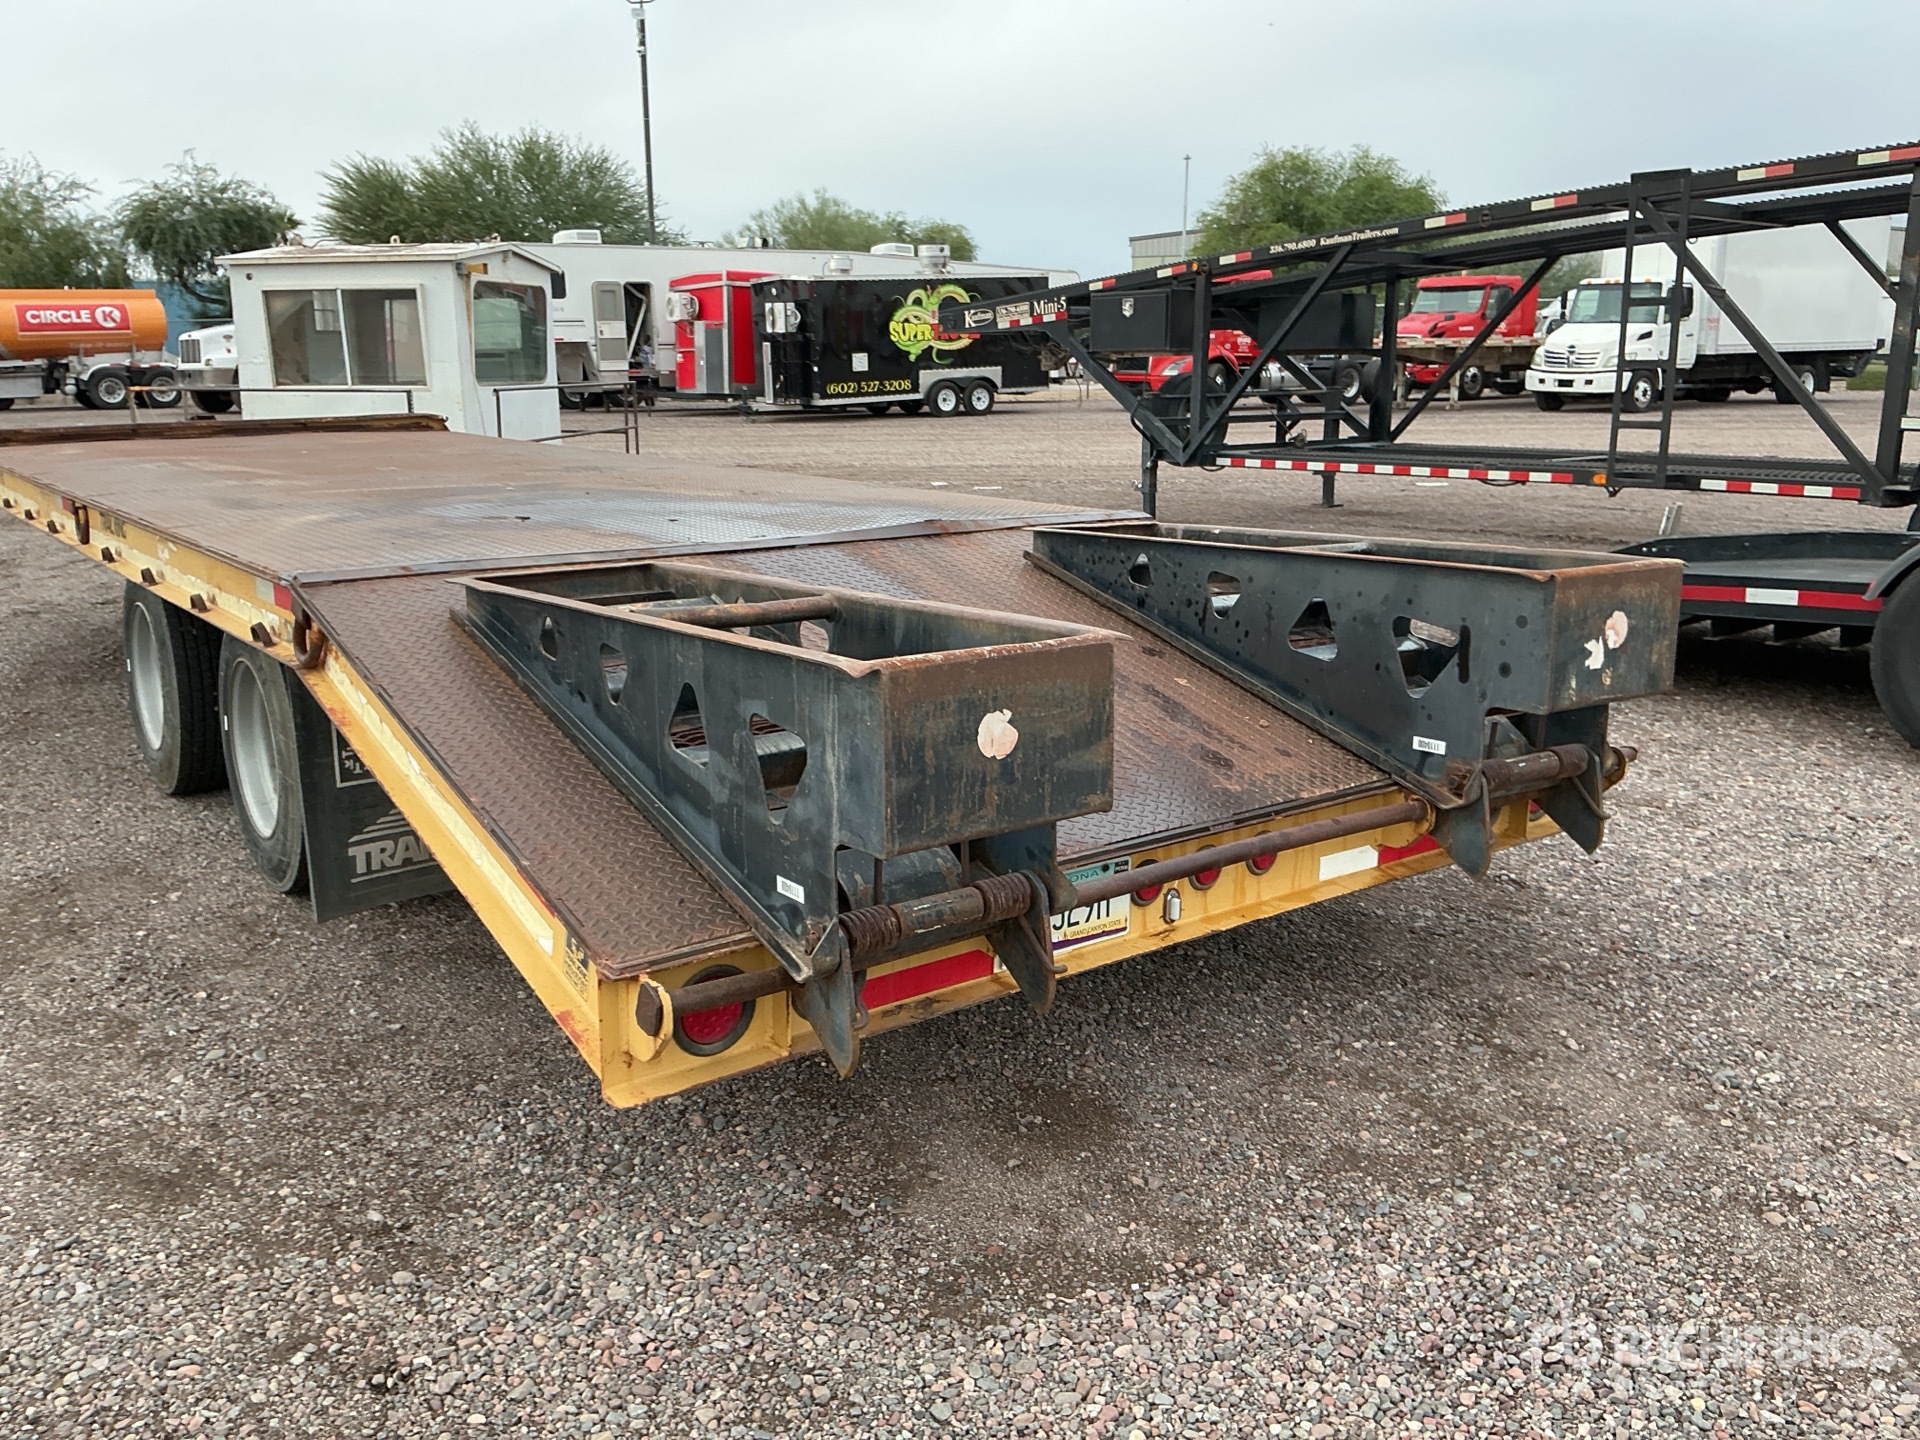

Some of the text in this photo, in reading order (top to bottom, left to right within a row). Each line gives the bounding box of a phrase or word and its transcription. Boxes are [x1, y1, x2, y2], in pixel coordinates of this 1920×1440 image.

[1320, 227, 1399, 246] KaufmanTrailers.com
[1033, 297, 1067, 316] Mini-5
[25, 307, 121, 327] CIRCLE K
[889, 321, 932, 342] SUPER
[826, 379, 912, 395] (602) 527-3208
[1069, 918, 1122, 938] GRAND CANYON STATE
